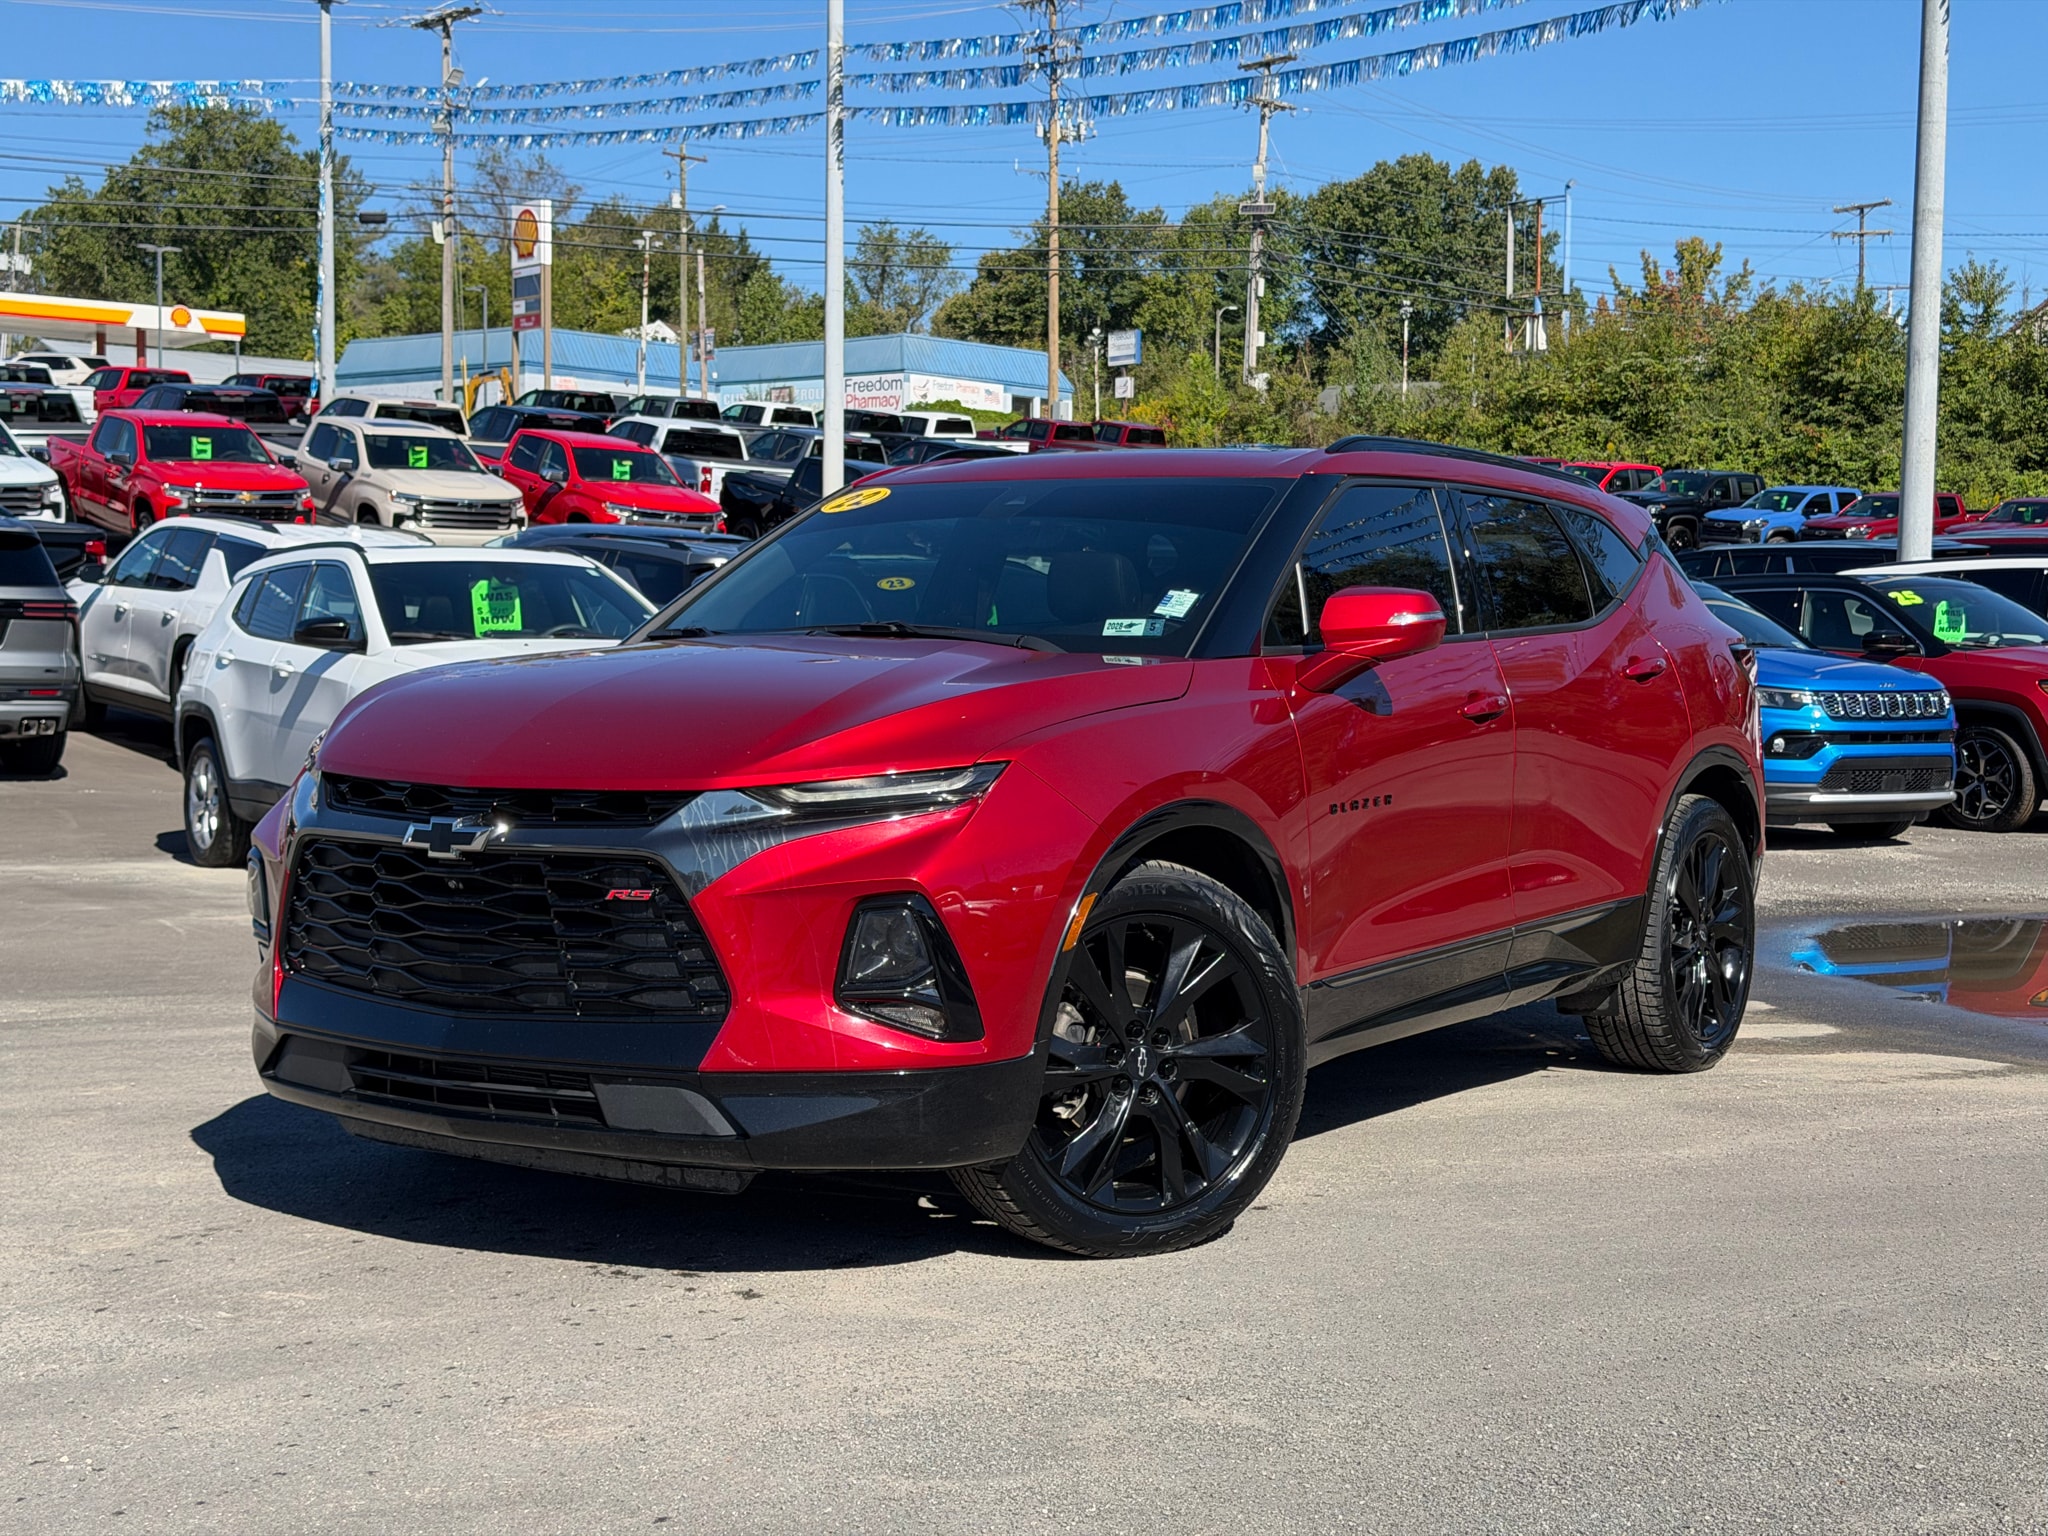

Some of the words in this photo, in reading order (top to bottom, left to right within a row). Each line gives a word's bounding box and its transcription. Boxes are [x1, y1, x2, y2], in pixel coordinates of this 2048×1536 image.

[844, 377, 902, 393] Freedom
[845, 393, 901, 410] Pharmacy
[886, 579, 905, 589] 23
[480, 592, 513, 602] WAS
[1888, 590, 1924, 606] 25
[480, 615, 515, 625] NOW
[1149, 622, 1157, 632] 5
[1329, 794, 1393, 815] BLAZER
[605, 889, 653, 901] RS
